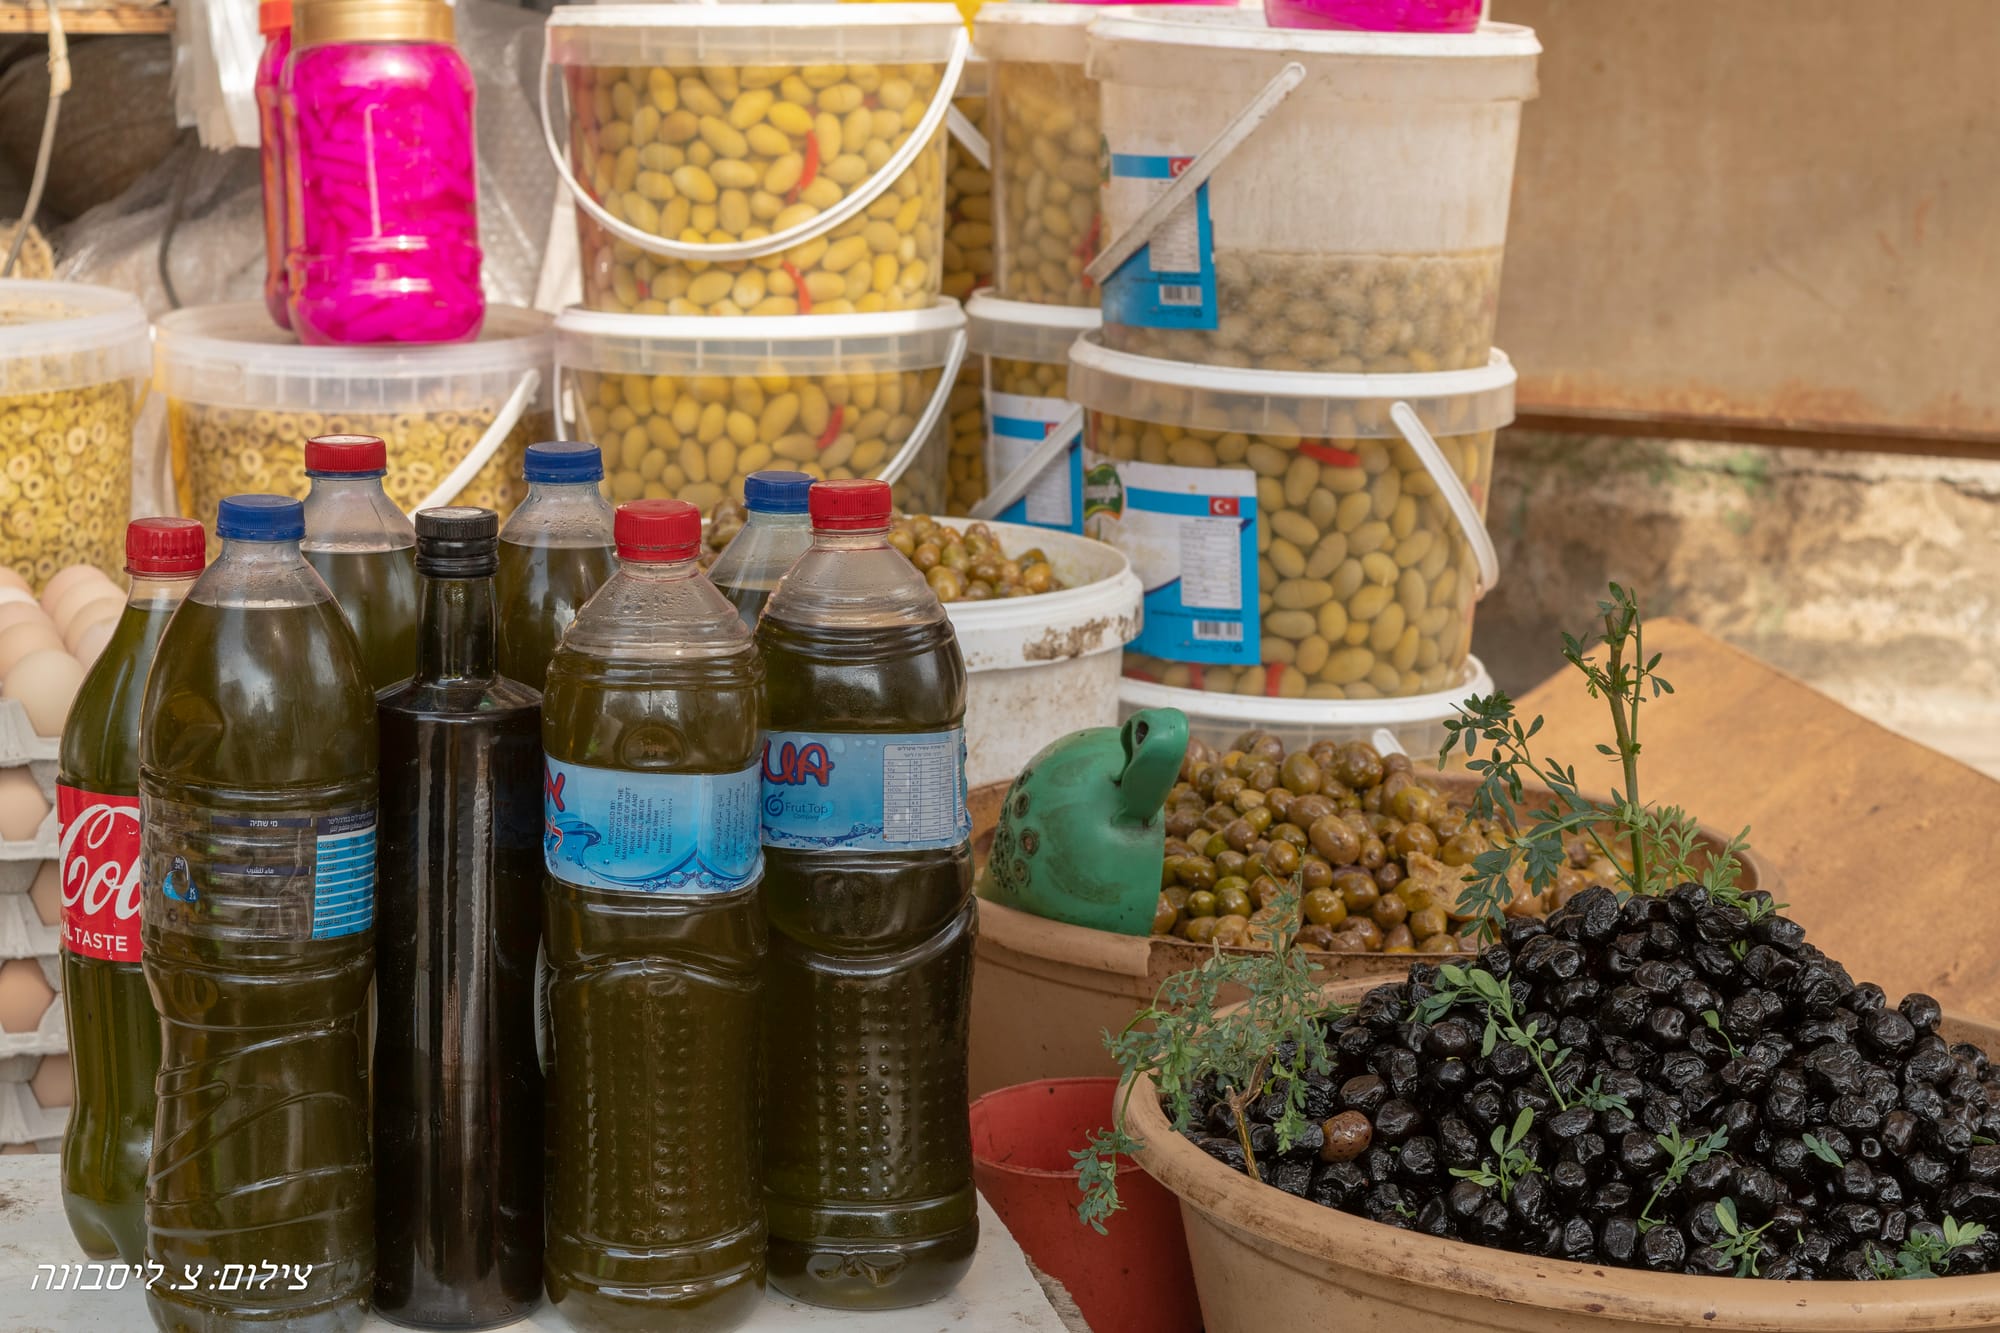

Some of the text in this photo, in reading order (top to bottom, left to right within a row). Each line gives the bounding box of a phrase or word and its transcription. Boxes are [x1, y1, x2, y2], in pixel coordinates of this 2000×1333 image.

[785, 801, 829, 816] Frut Top
[249, 819, 278, 828] מי שתיה
[607, 811, 616, 846] PRODUCED
[621, 814, 630, 860] MANUFACTURE
[246, 866, 264, 876] للشرب
[74, 927, 129, 952] TASTE
